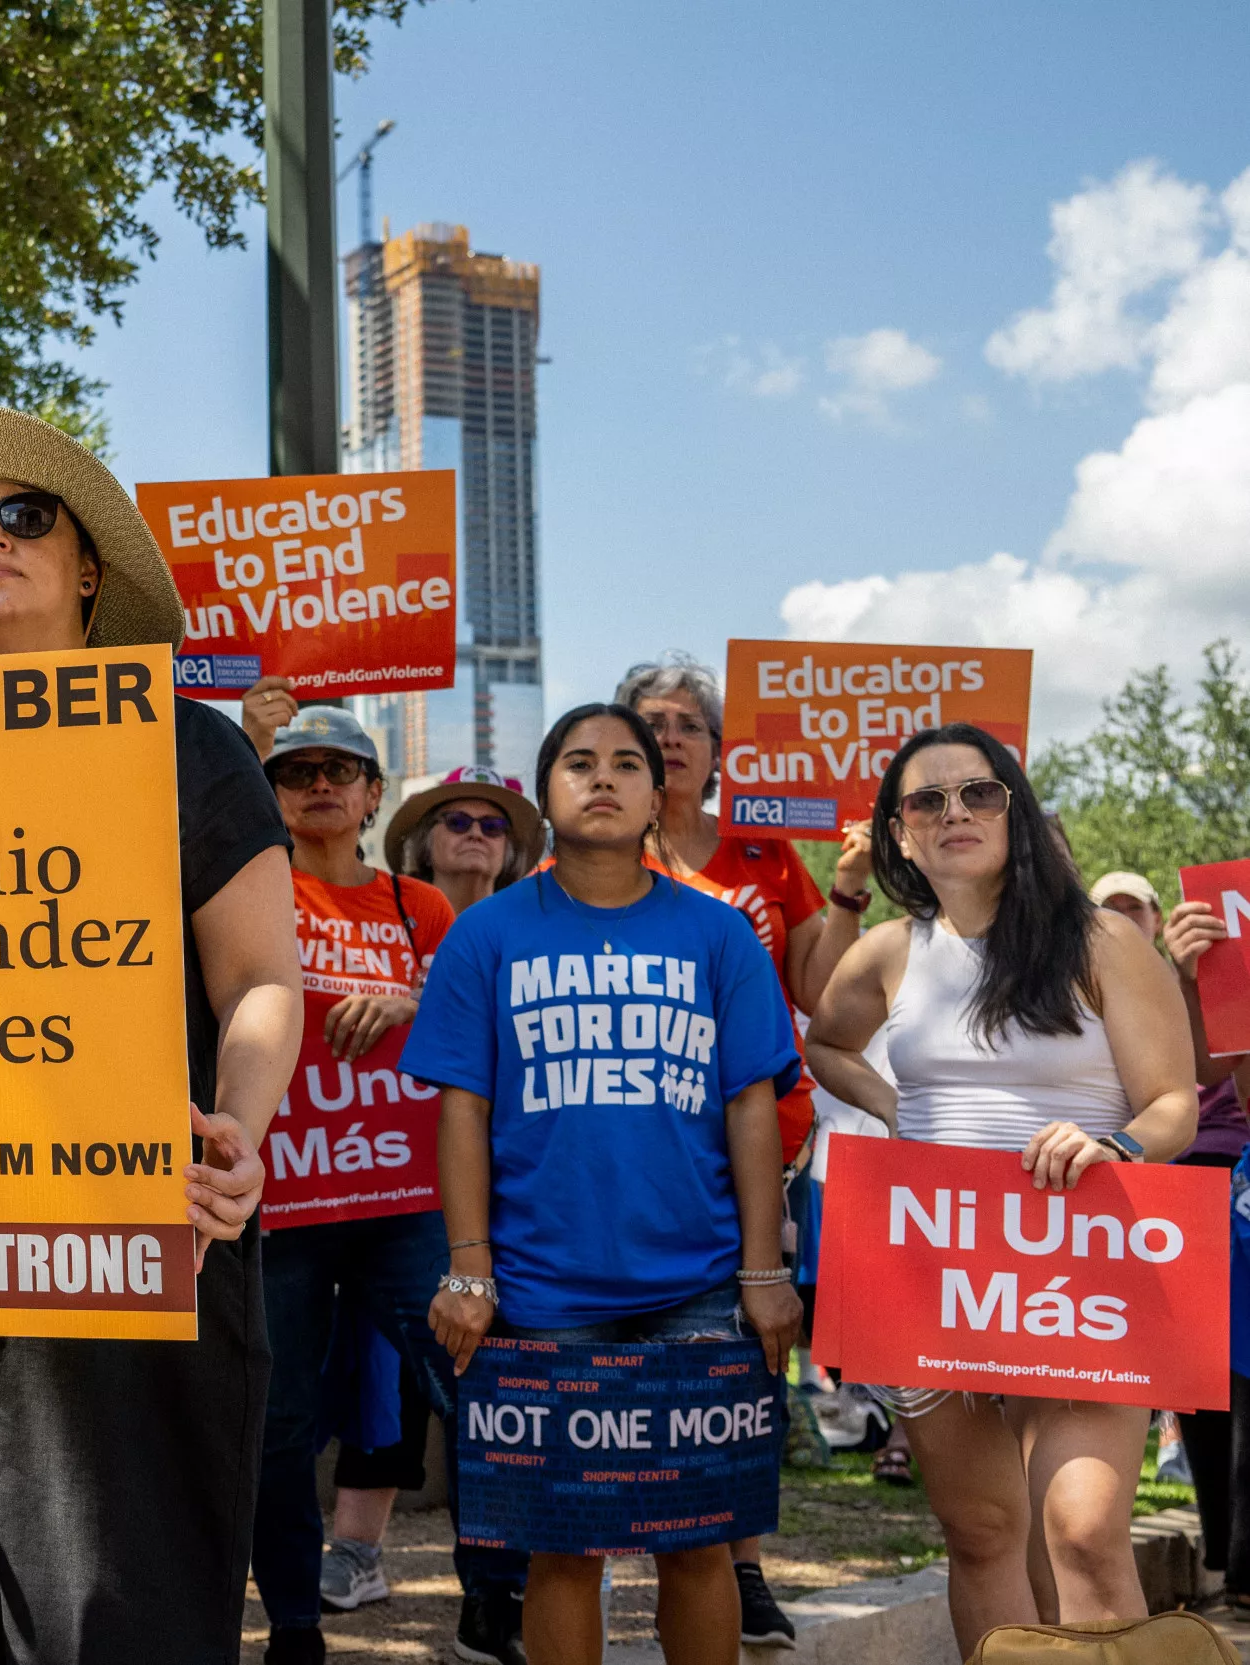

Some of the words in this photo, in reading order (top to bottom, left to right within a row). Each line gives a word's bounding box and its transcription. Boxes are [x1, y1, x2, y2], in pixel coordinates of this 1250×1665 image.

[168, 487, 406, 548] Educators
[214, 549, 265, 590] to
[272, 528, 365, 584] End
[184, 603, 234, 640] un
[237, 576, 450, 634] Violence
[288, 664, 443, 690] a.org/EndGunViolence
[758, 656, 984, 699] Educators
[800, 702, 848, 739] to
[858, 692, 941, 737] End
[726, 744, 814, 784] Gun
[734, 798, 783, 824] nea
[310, 913, 354, 941] NOT
[295, 937, 393, 977] WHEN
[322, 979, 354, 993] GUN
[510, 954, 696, 1008] MARCH
[512, 1004, 613, 1060] FOR
[621, 1003, 716, 1065] OUR
[522, 1058, 657, 1114] LIVES
[51, 1142, 173, 1176] NOW!
[269, 1121, 412, 1181] Más
[262, 1185, 434, 1215] EverytownSupportFund.org/Latinx
[889, 1186, 976, 1250] Ni
[1003, 1192, 1184, 1263] Uno
[941, 1268, 1128, 1341] Más
[519, 1340, 560, 1353] SCHOOL
[592, 1355, 644, 1368] WALMART
[498, 1376, 550, 1391] SHOPPING
[556, 1379, 600, 1393] CENTER
[582, 1368, 625, 1380] SCHOOL
[636, 1380, 667, 1392] MOVIE
[676, 1378, 723, 1391] THEATER
[708, 1363, 750, 1378] CHURCH
[918, 1355, 1151, 1385] EverytownSupportFund.org/Latinx
[468, 1401, 550, 1446] NOT
[568, 1409, 652, 1450] ONE
[669, 1395, 774, 1448] MORE
[485, 1451, 546, 1467] UNIVERSITY
[582, 1471, 635, 1483] SHOPPING
[638, 1469, 680, 1482] CENTER
[631, 1517, 697, 1533] ELEMENTARY
[698, 1511, 734, 1526] SCHOOL
